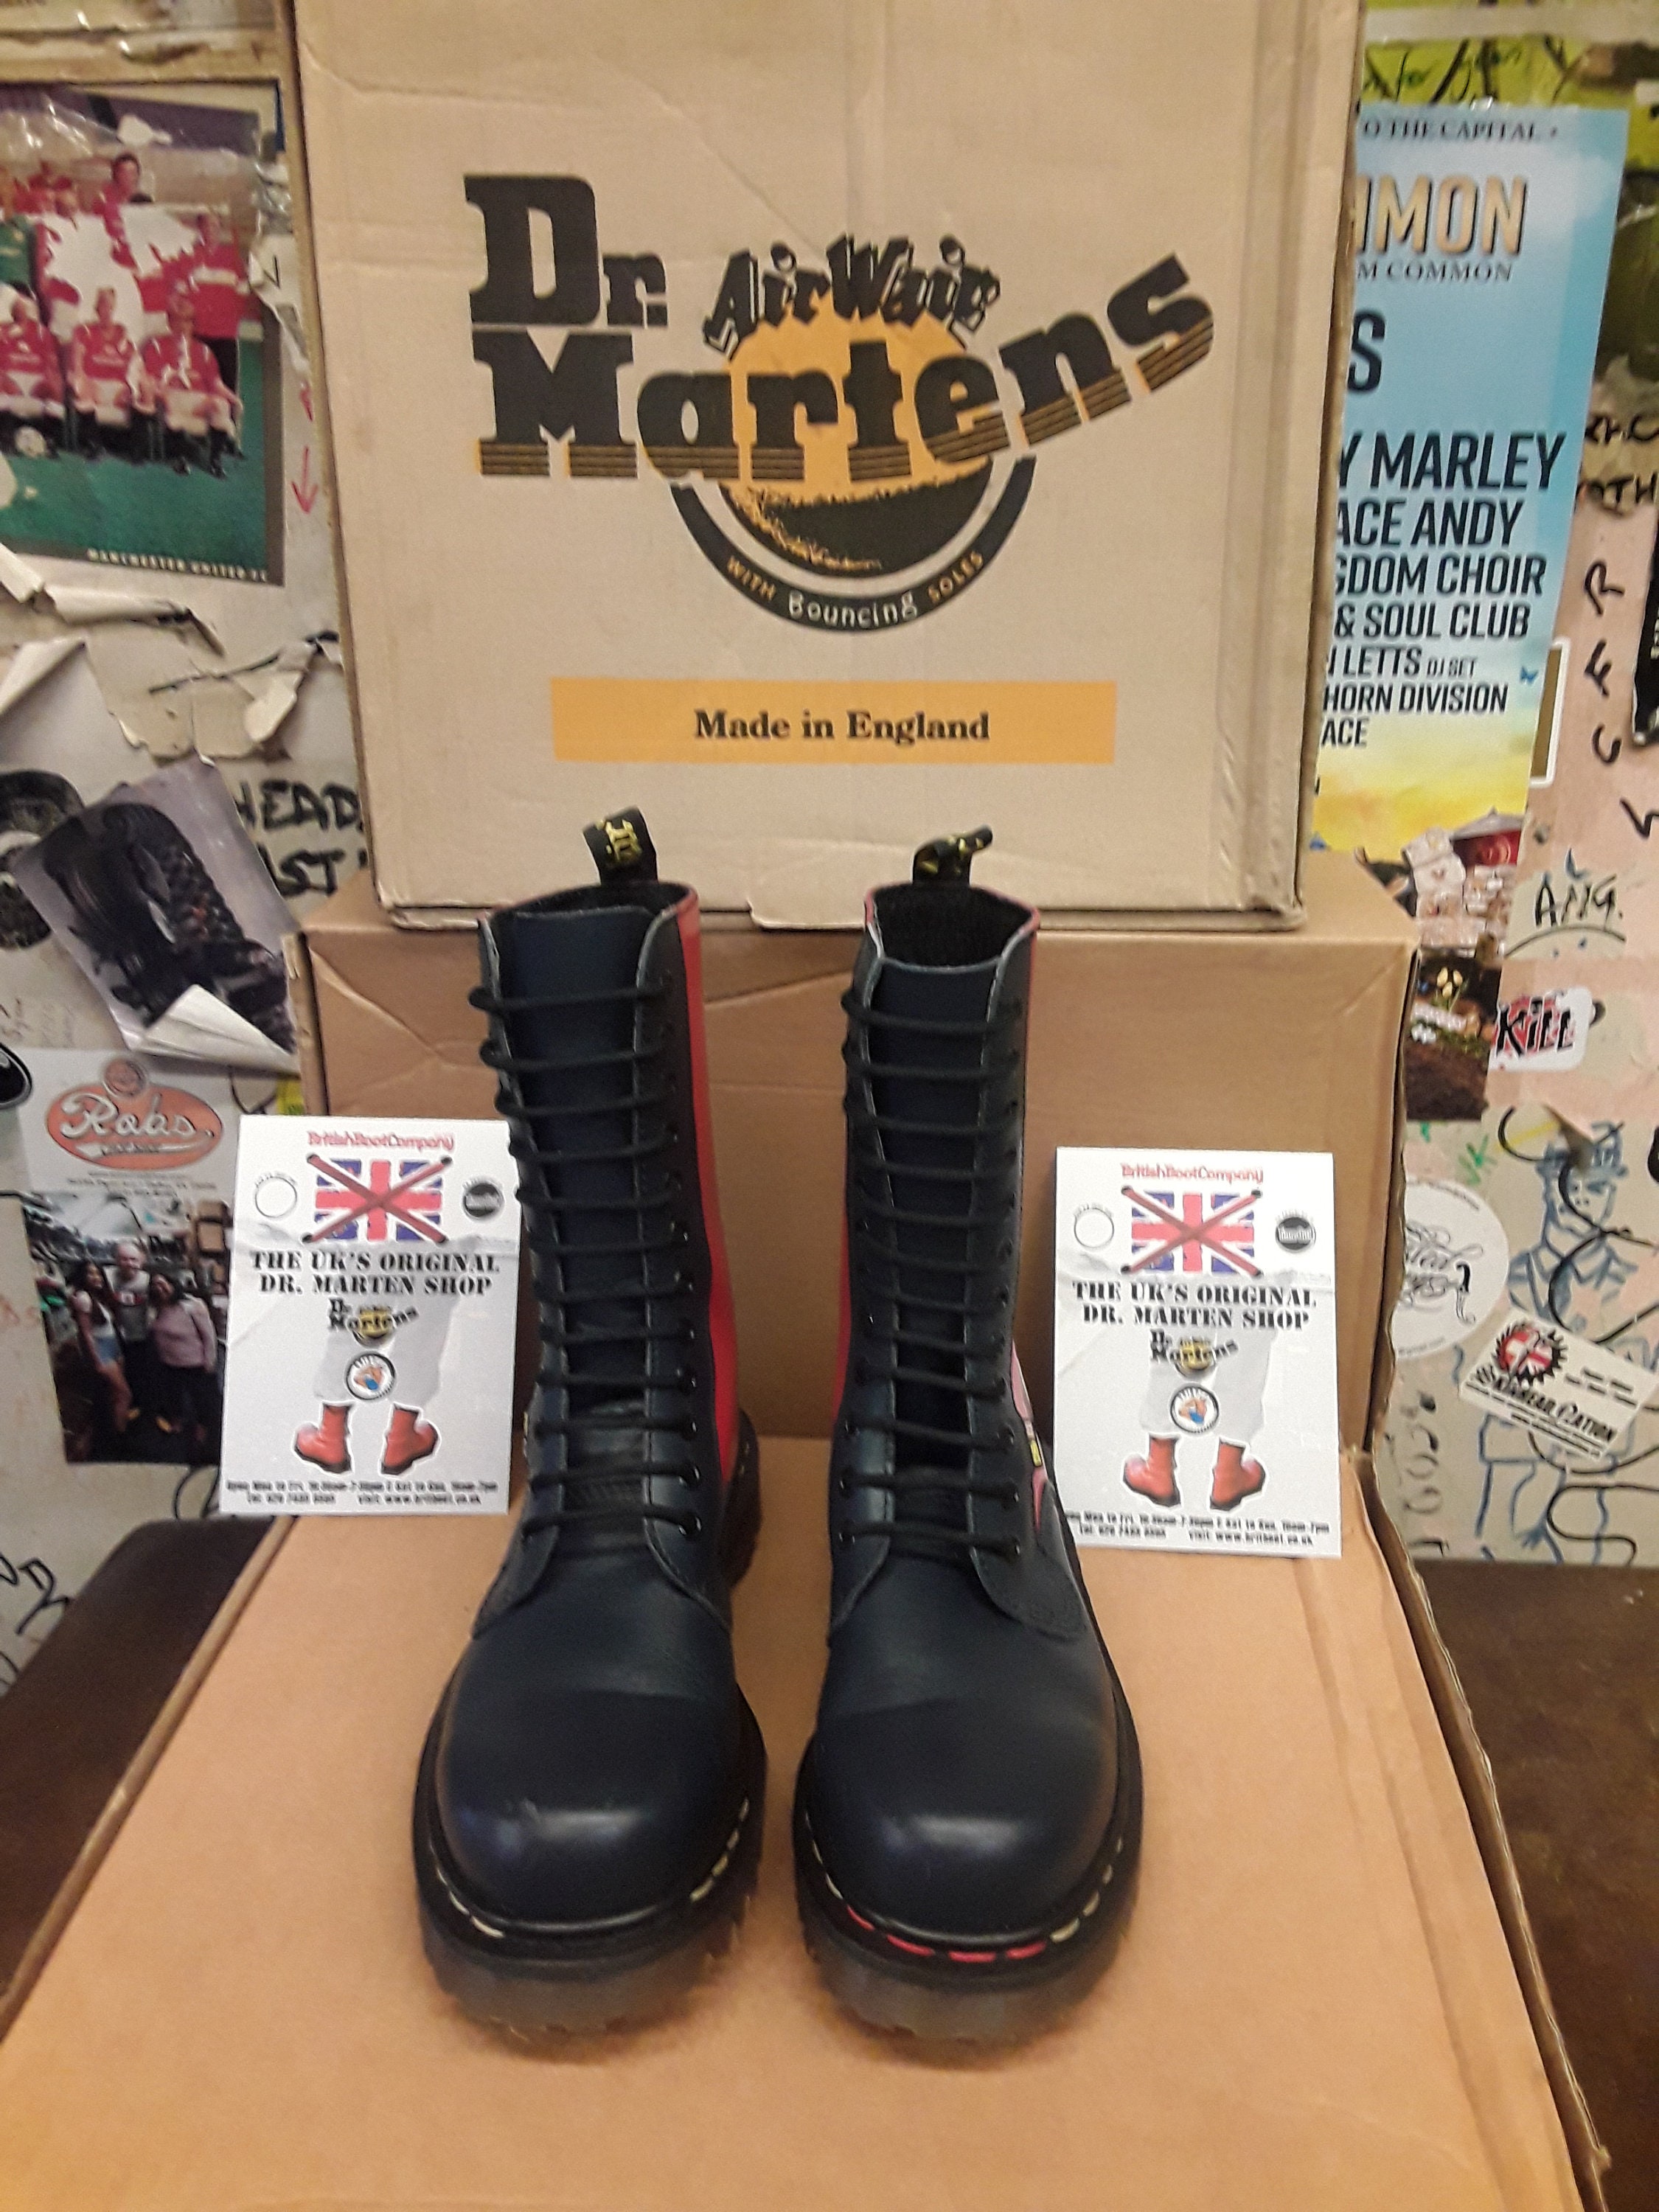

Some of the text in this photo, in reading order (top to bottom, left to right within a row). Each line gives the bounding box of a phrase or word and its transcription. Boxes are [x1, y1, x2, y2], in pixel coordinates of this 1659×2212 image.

[1388, 120, 1428, 139] THE
[1438, 120, 1543, 140] CAPITAL
[1386, 260, 1514, 282] COMMON
[703, 232, 1001, 363] AirWair
[472, 251, 1214, 483] Martens
[1370, 431, 1567, 491] MARLEY
[1410, 498, 1523, 547] ANDY
[725, 554, 776, 603] WITH
[927, 552, 985, 603] SOLES
[1436, 553, 1547, 596] CHOIR
[788, 590, 919, 630] Bouncing
[1333, 602, 1531, 639] & SOUL CLUB
[1343, 644, 1423, 678] LETTS
[1323, 683, 1509, 714] HORN DIVISION
[693, 708, 992, 745] Made in England
[251, 1251, 500, 1273] THE UK'S ORIGINAL
[260, 1274, 493, 1296] DR. MARTEN SHOP
[1072, 1281, 1318, 1307] THE UK'S ORIGINAL
[1082, 1304, 1311, 1332] DR. MARTEN SHOP
